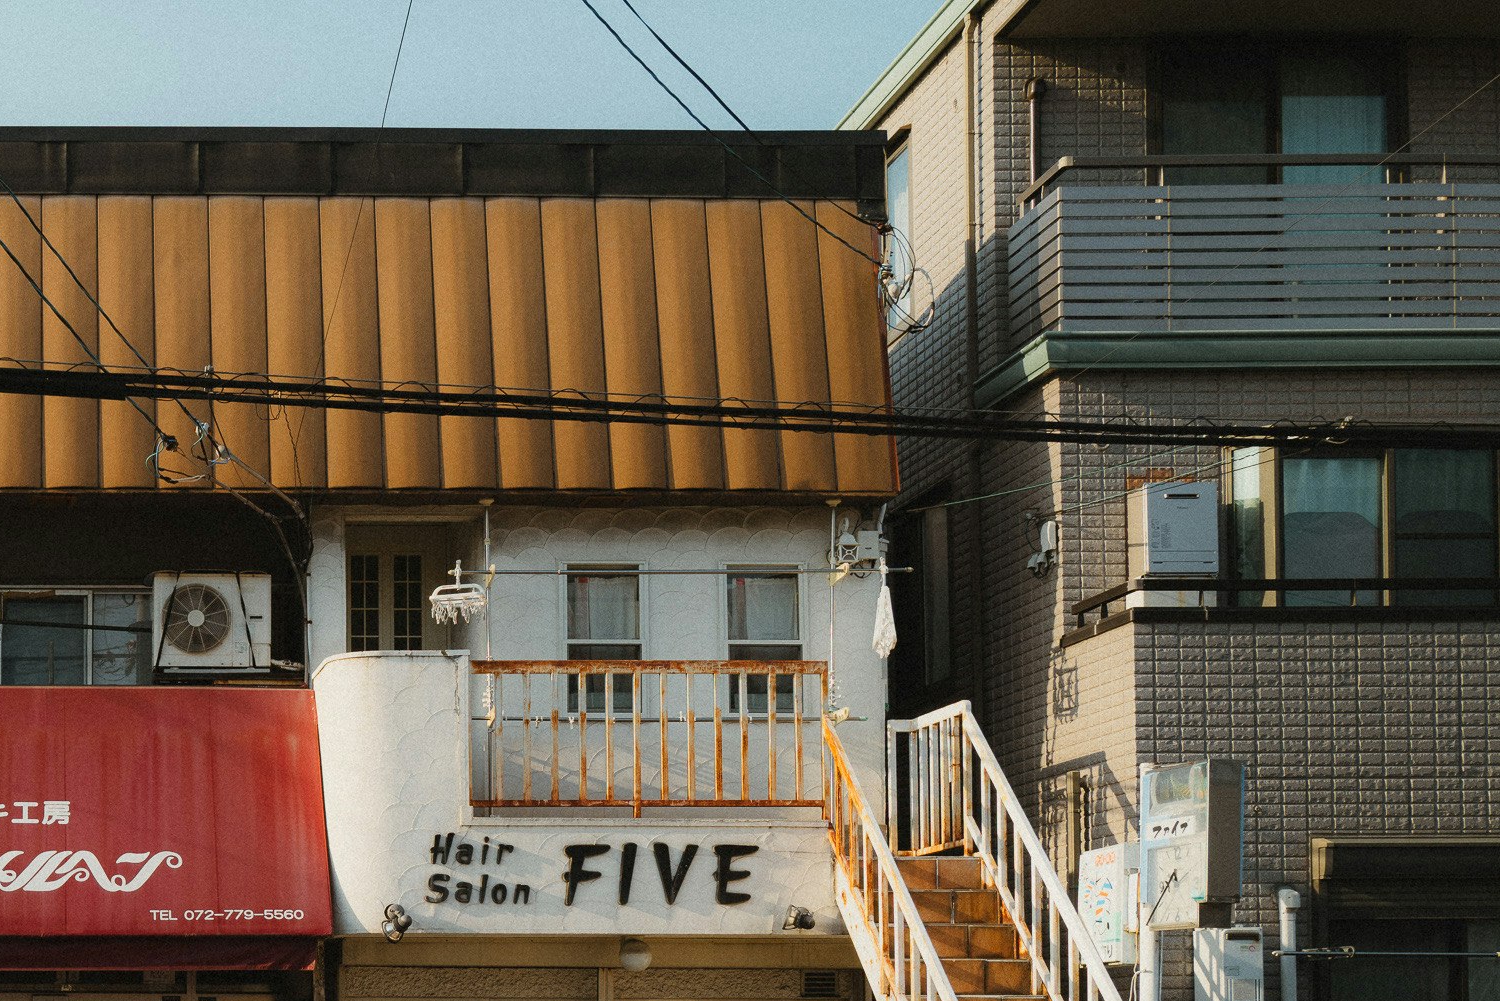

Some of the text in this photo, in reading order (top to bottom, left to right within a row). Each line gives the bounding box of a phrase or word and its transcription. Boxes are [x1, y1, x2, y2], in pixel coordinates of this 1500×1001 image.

[430, 832, 514, 866] Hair
[425, 873, 531, 905] Salon
[562, 842, 760, 907] FIVE
[149, 908, 305, 921] TEL 072-779-5560
